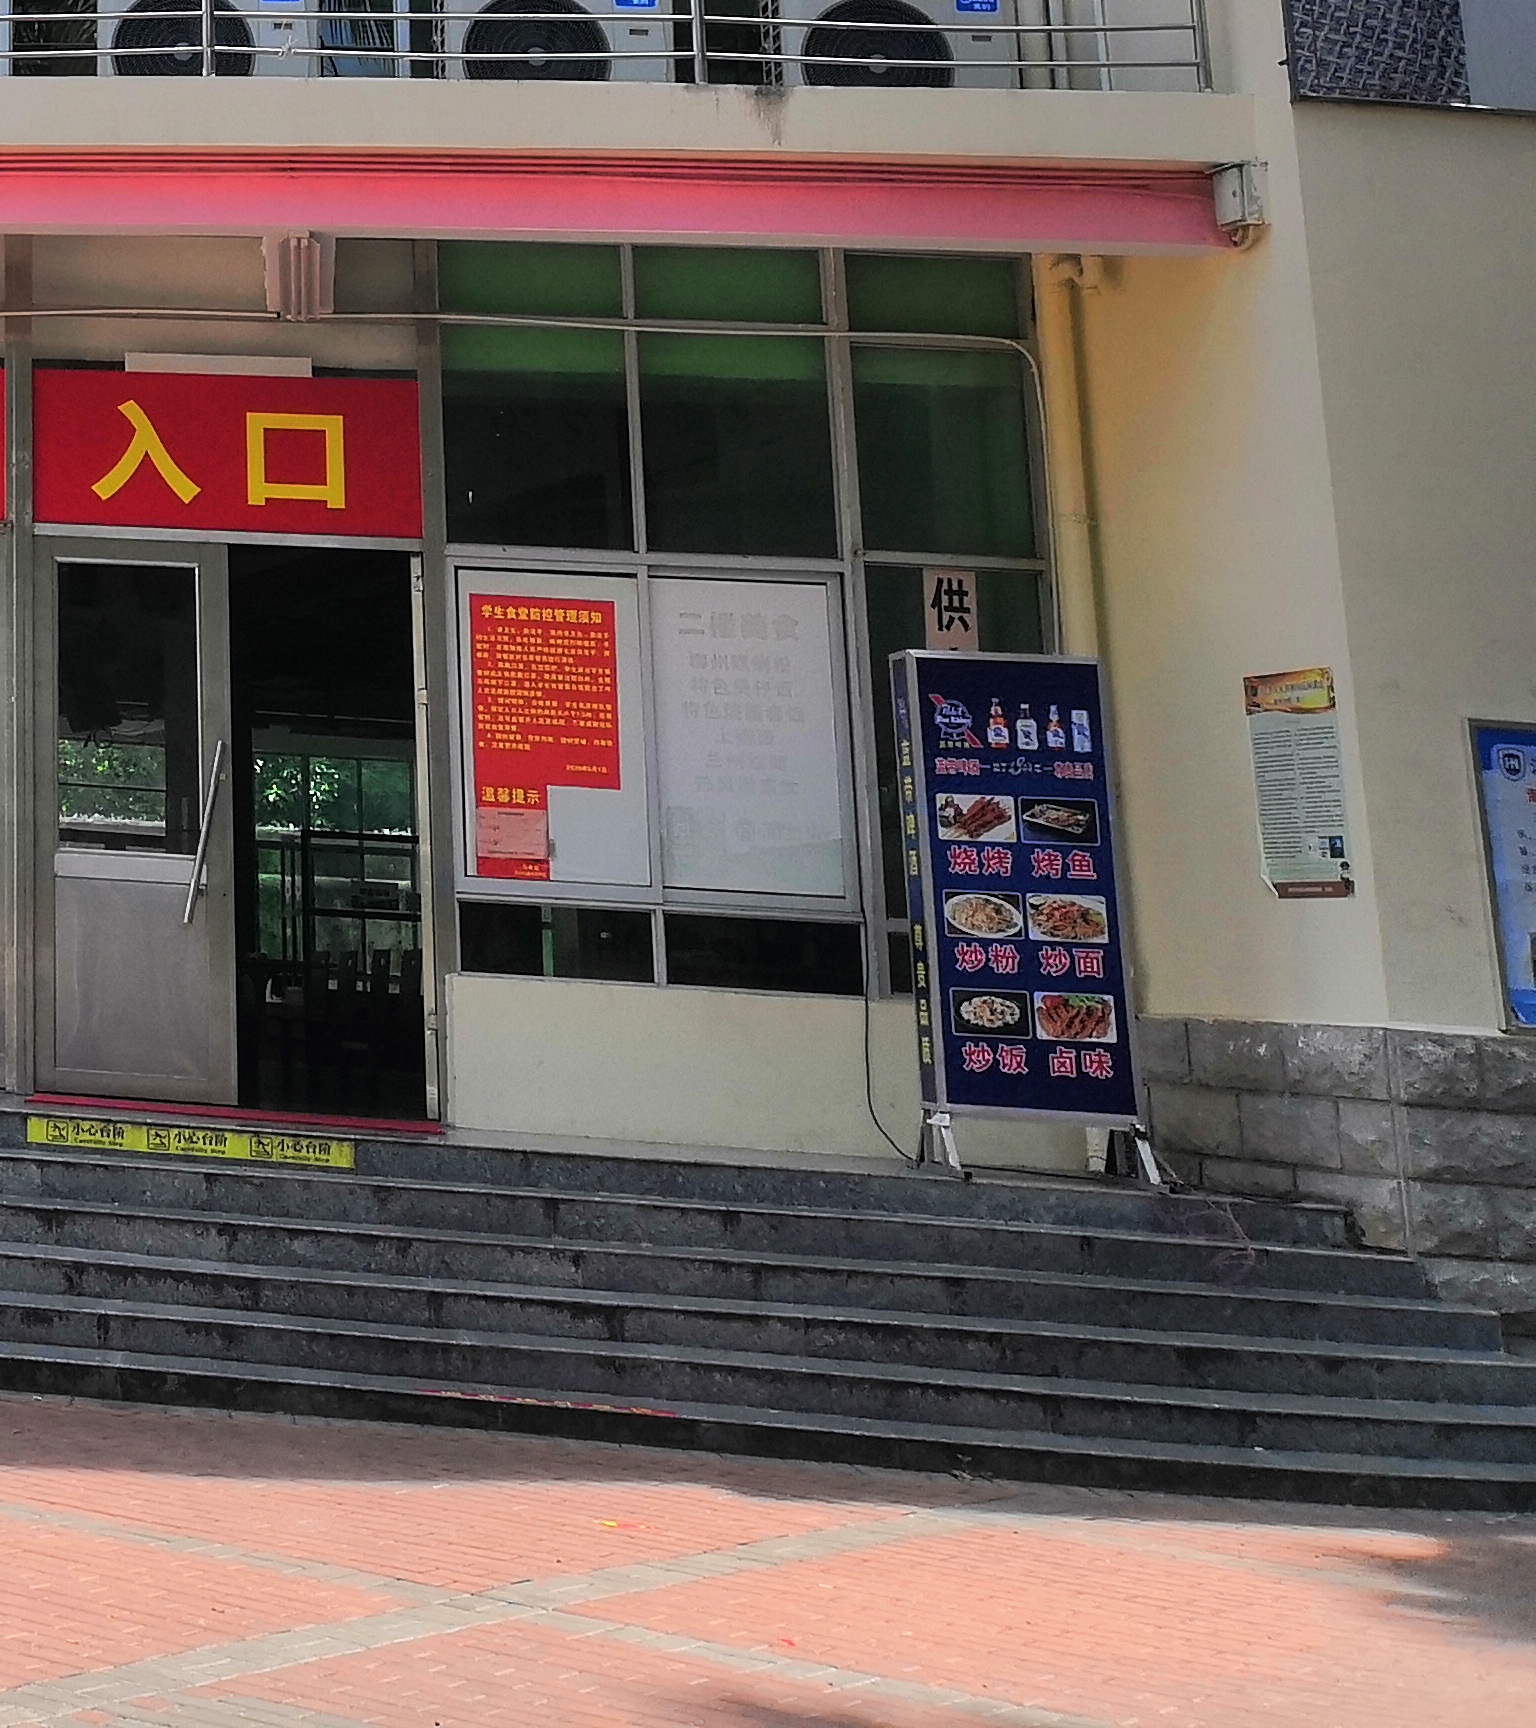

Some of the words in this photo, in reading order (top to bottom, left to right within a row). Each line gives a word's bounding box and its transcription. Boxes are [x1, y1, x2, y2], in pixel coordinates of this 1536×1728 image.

[91, 399, 346, 509] 入口
[931, 577, 970, 632] 供
[482, 786, 541, 804] 温馨提示
[948, 845, 1011, 876] 烧烤
[1032, 849, 1097, 880] 烤鱼
[956, 942, 1019, 973] 炒粉
[1040, 946, 1103, 978] 炒面
[962, 1042, 1028, 1074] 炒饭
[1050, 1046, 1113, 1079] 卤味
[72, 1123, 124, 1139] 小心台阶
[173, 1130, 228, 1147] 小心台阶
[277, 1139, 331, 1155] 小心台阶
